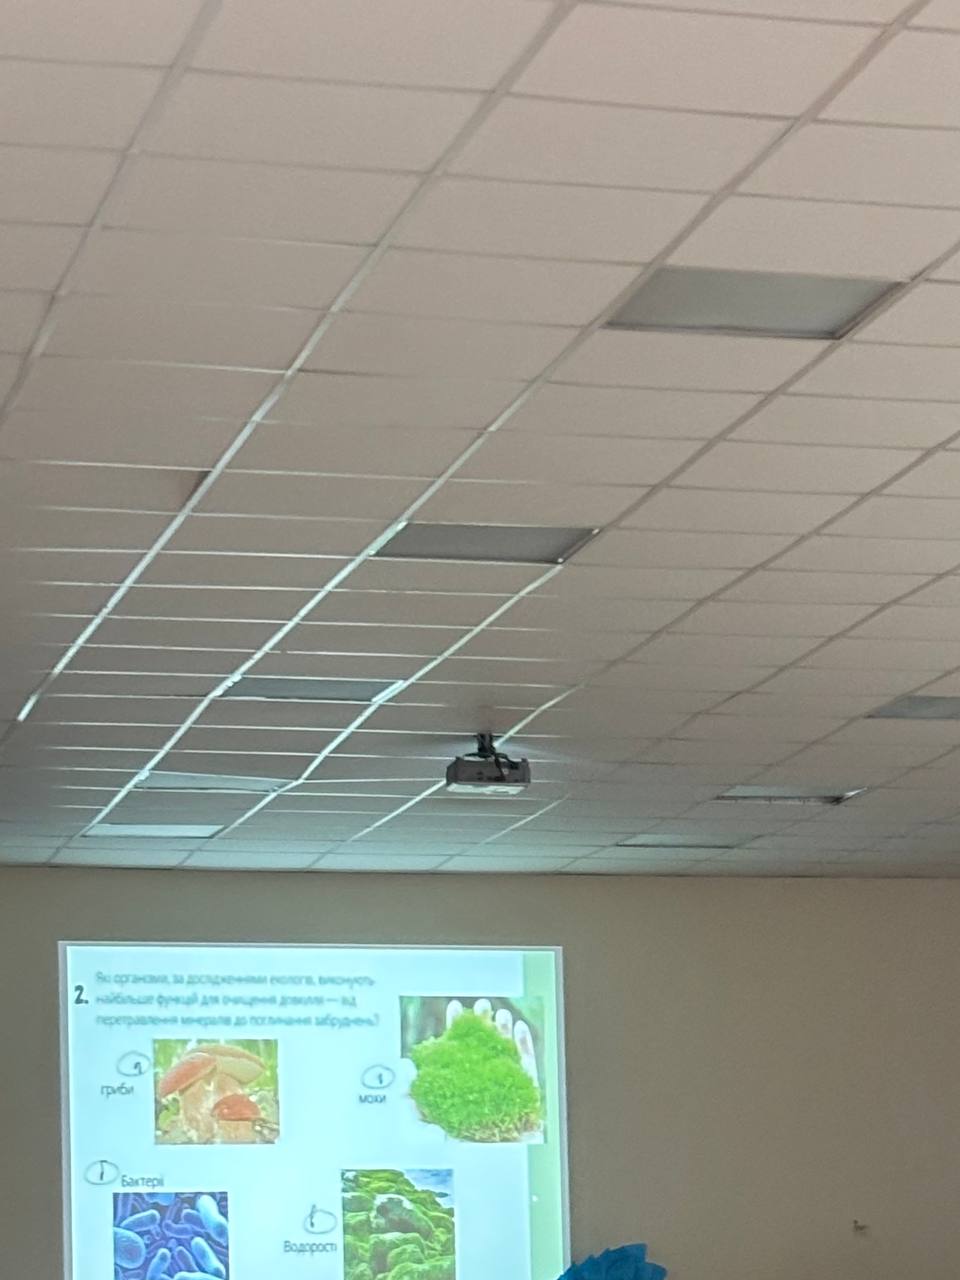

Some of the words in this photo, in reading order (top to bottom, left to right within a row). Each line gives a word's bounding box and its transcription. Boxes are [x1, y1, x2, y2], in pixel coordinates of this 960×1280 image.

[74, 984, 89, 1004] 2.
[101, 1082, 134, 1099] гриби
[359, 1094, 386, 1104] мохи
